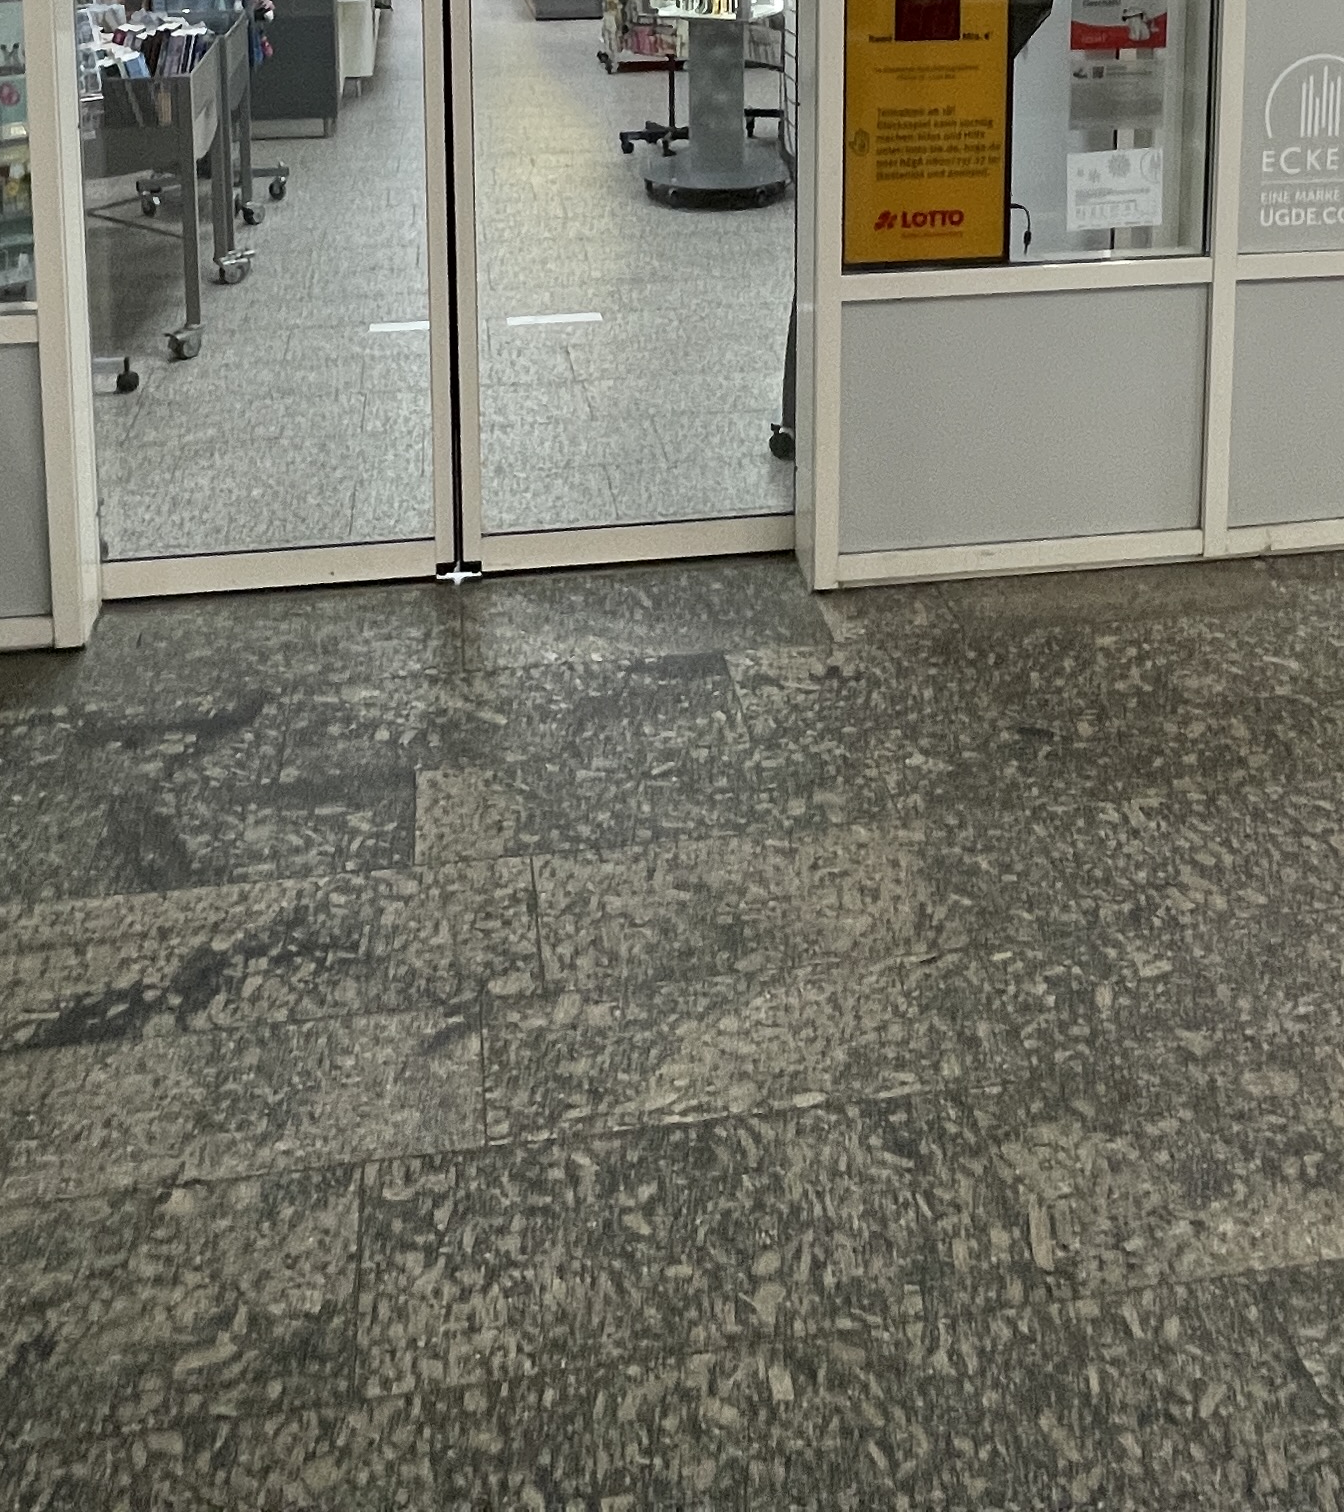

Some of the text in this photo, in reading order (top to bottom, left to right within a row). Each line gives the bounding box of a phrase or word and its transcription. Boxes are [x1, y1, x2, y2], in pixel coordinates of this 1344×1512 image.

[1260, 191, 1291, 205] EINE
[1295, 189, 1340, 203] MARKE
[900, 209, 965, 229] LOTTO
